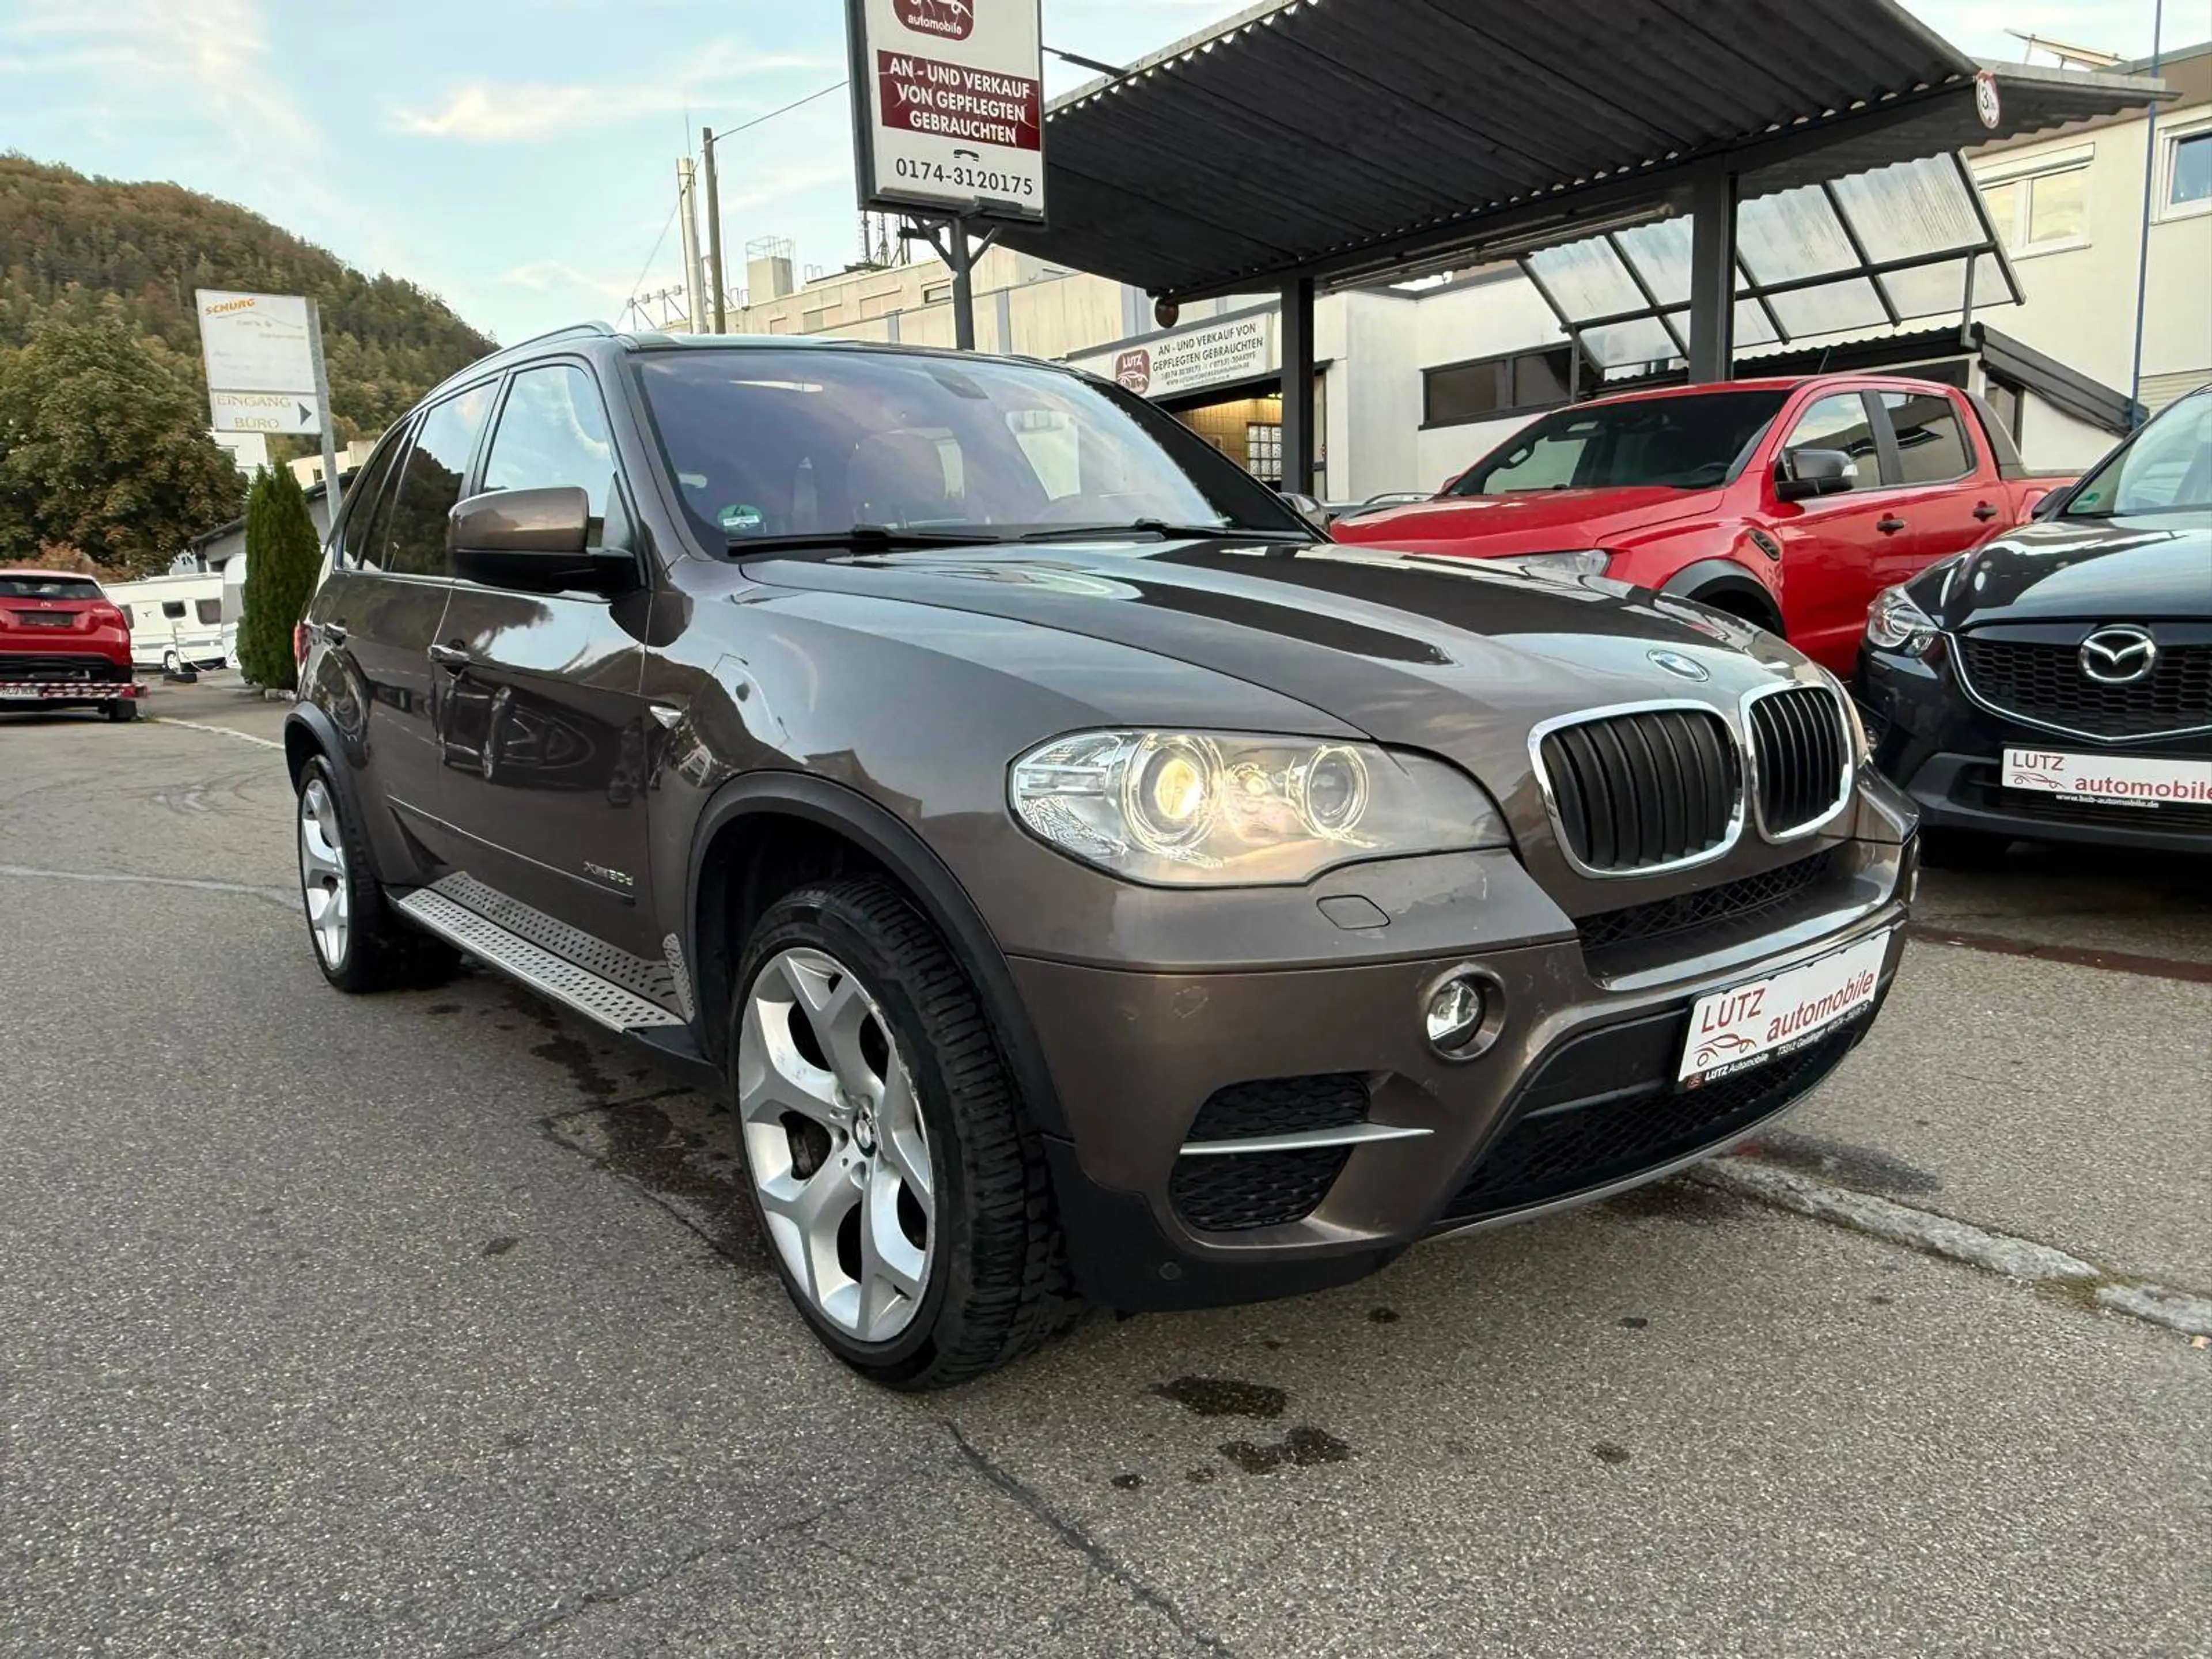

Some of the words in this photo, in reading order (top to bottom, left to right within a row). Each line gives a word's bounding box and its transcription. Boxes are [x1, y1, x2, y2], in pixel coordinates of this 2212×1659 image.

[908, 14, 963, 35] automobile
[890, 58, 914, 77] AN
[927, 65, 960, 86] UND
[964, 70, 1031, 100] VERKAUF
[896, 82, 933, 106] VON
[936, 91, 1027, 122] GEPFLEGTEN
[910, 111, 1017, 144] GEBRAUCHTEN
[896, 158, 1033, 195] 0174-3120175
[1153, 354, 1201, 372] GEPFLEGTEN
[1202, 337, 1263, 361] GEBRAUCHTEN
[1158, 344, 1171, 356] AN
[1177, 339, 1195, 352] UND
[1196, 329, 1234, 346] VERKAUF
[1236, 323, 1256, 337] VON
[1122, 353, 1143, 369] LUTZ
[217, 396, 291, 408] EINGANG
[2013, 752, 2065, 771] LUTZ
[2075, 776, 2212, 800] automobile
[1702, 988, 1766, 1033] LUTZ
[1766, 969, 1874, 1043] automobile
[1705, 1067, 1728, 1081] LUTZ
